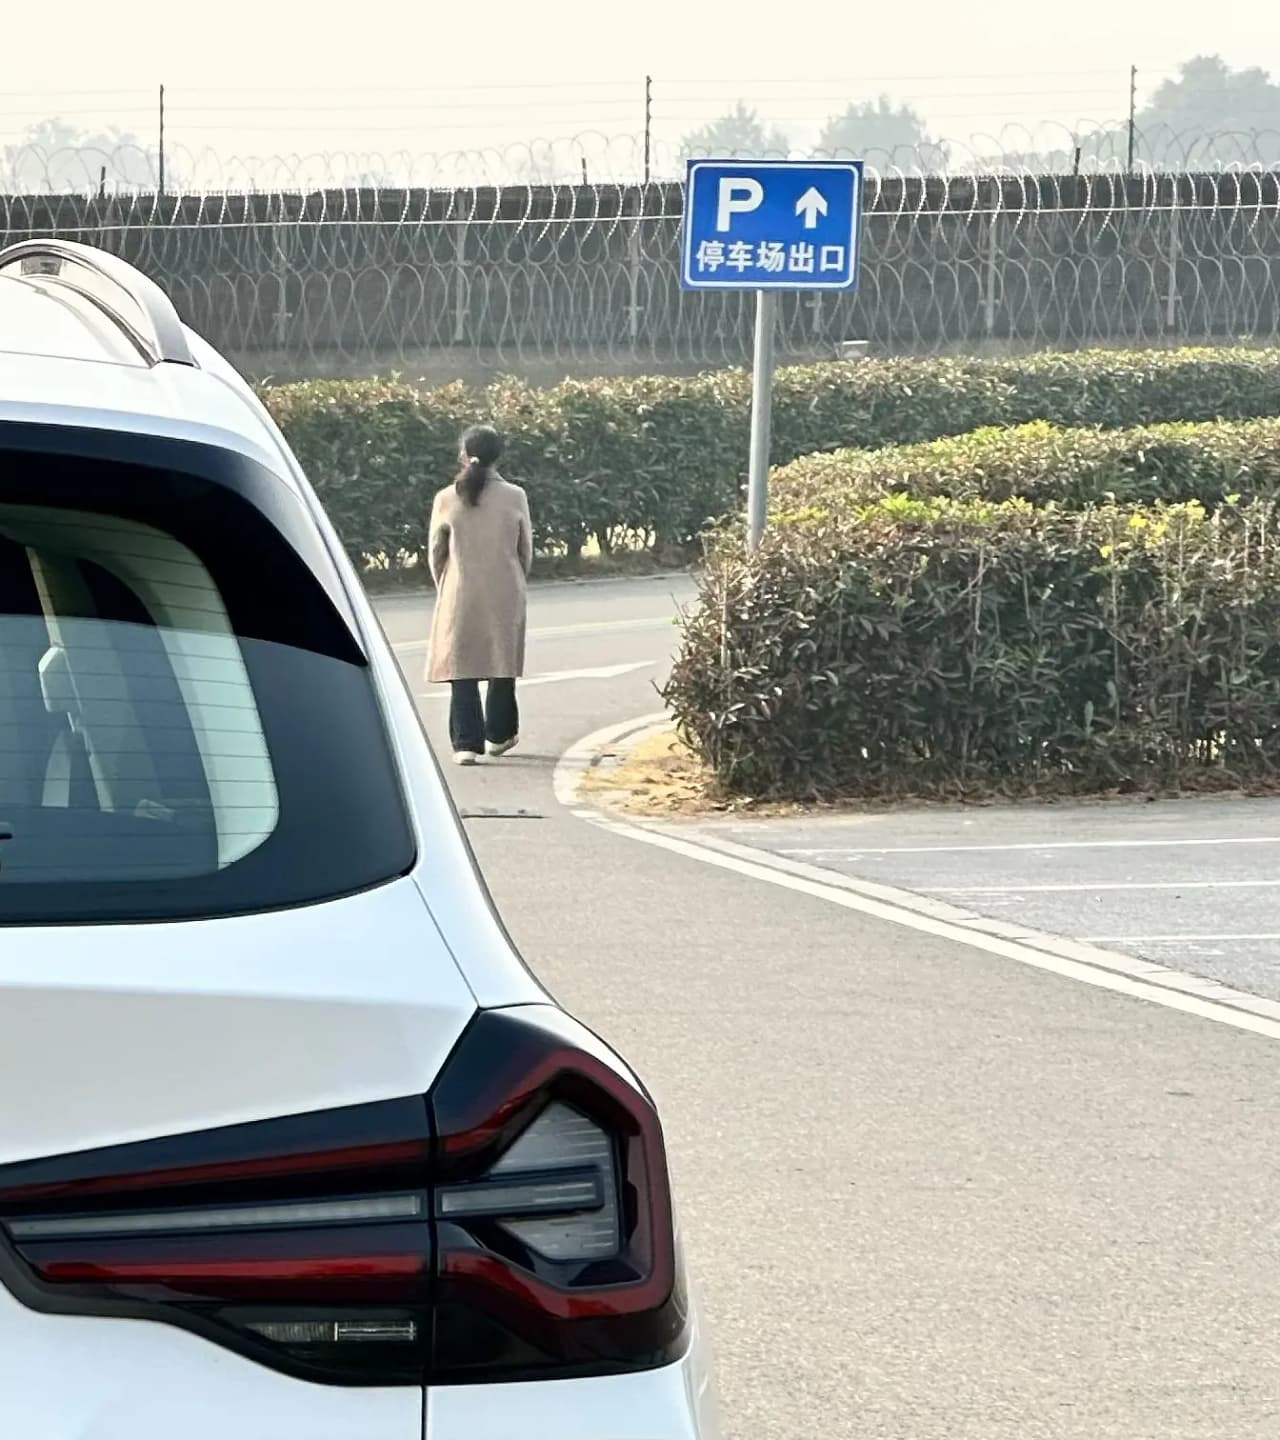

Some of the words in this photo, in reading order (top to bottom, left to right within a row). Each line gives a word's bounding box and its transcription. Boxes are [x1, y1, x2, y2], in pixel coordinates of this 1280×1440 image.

[716, 177, 764, 232] P
[695, 240, 845, 274] 停车场出口
